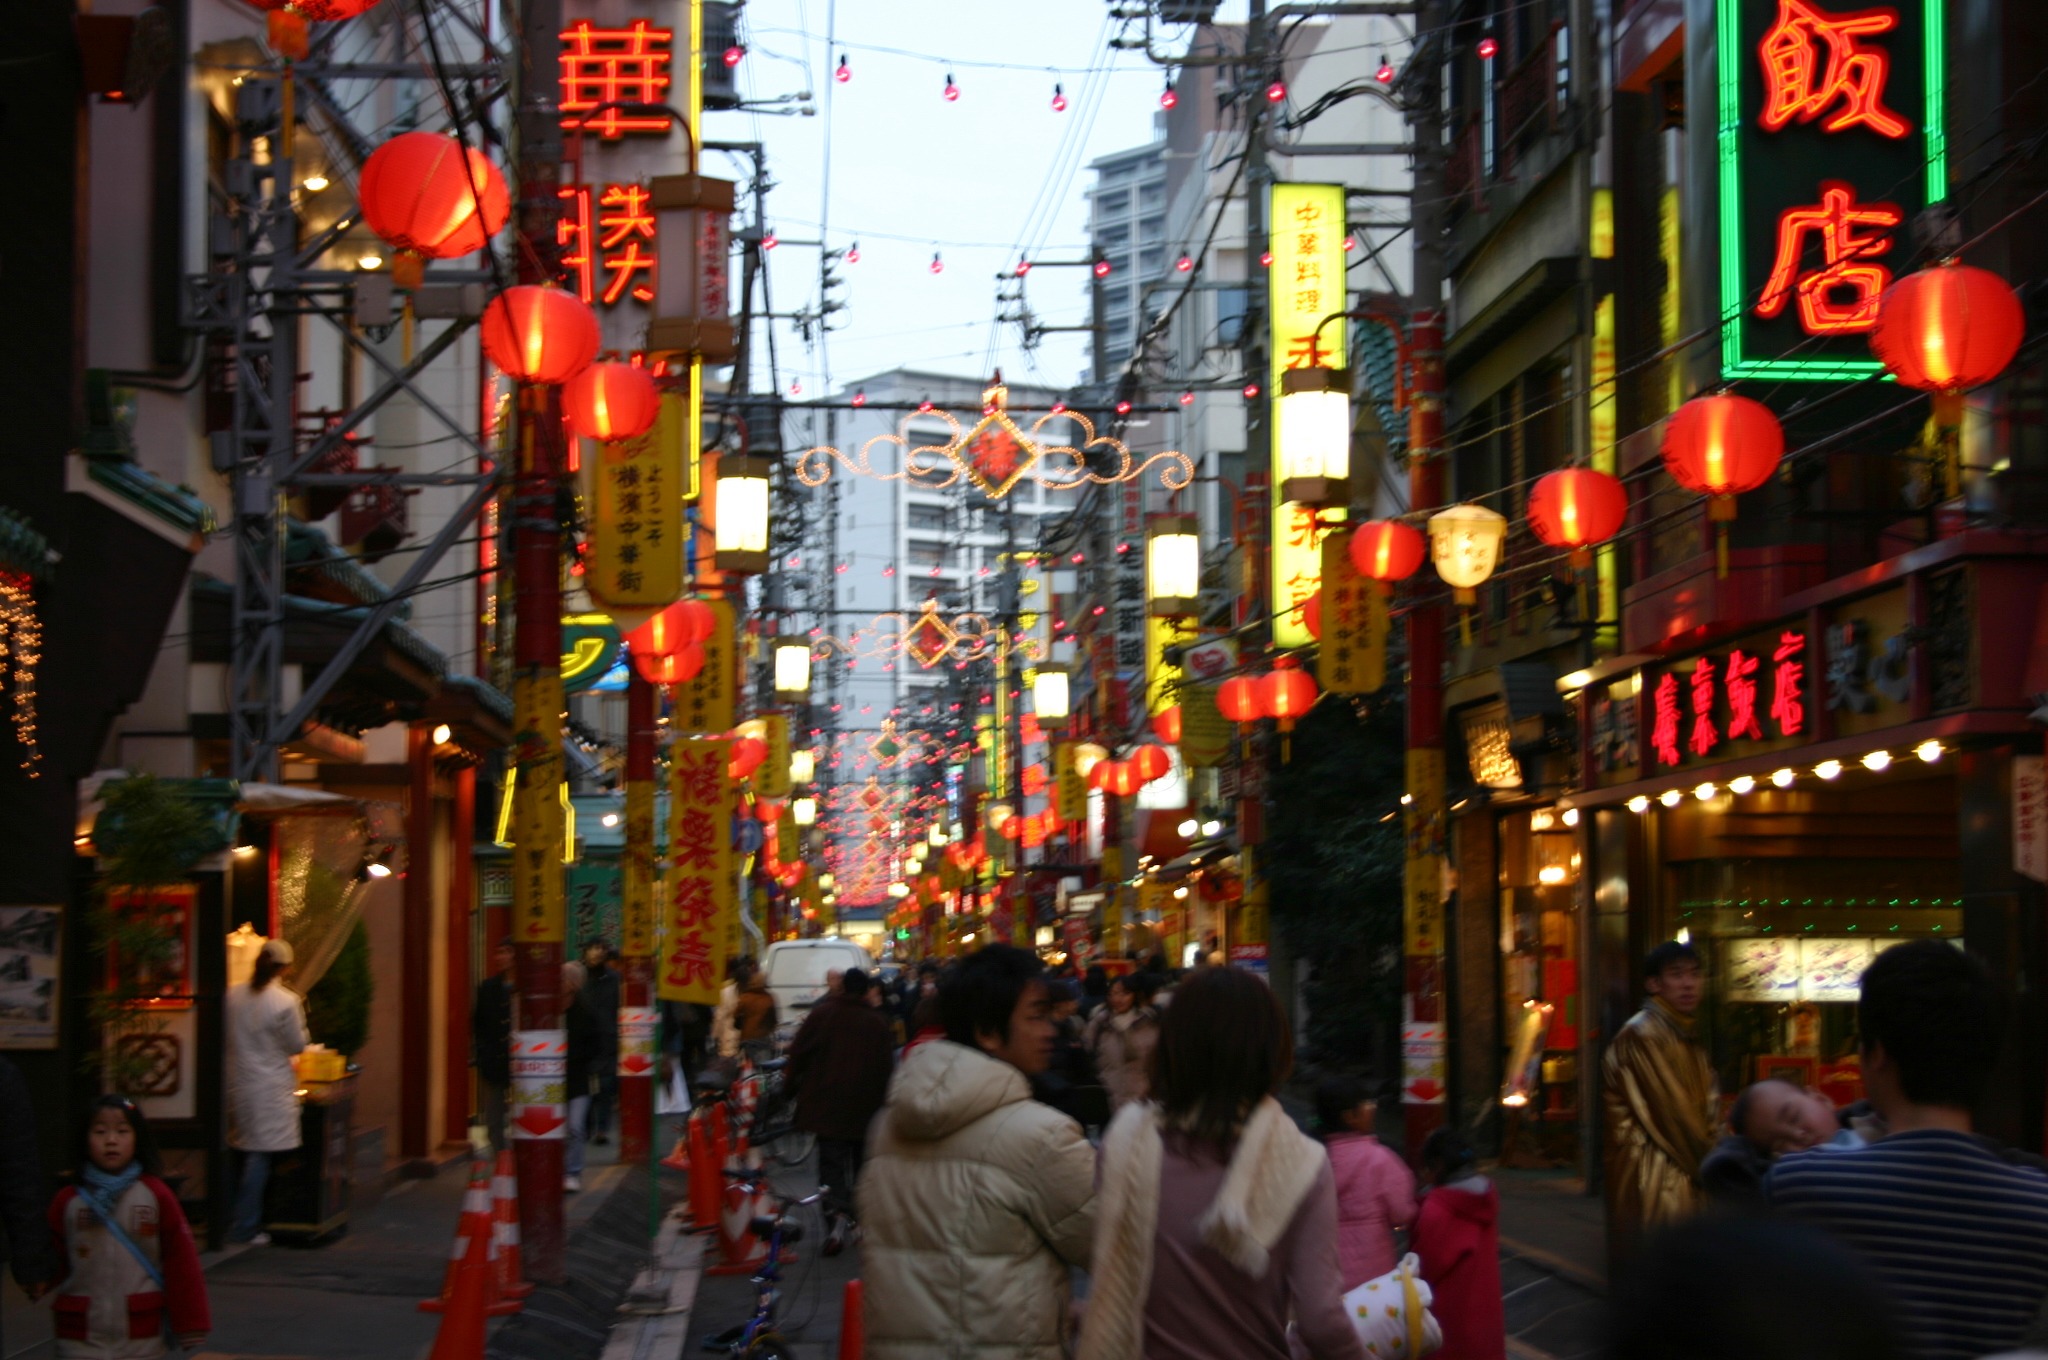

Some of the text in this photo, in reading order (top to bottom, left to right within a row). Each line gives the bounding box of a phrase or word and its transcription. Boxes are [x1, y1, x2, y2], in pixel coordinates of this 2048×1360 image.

[557, 20, 674, 378] 華勝
[1296, 201, 1321, 313] 中華料理
[1757, 0, 1909, 334] 飯店
[644, 463, 665, 548] ようこそ
